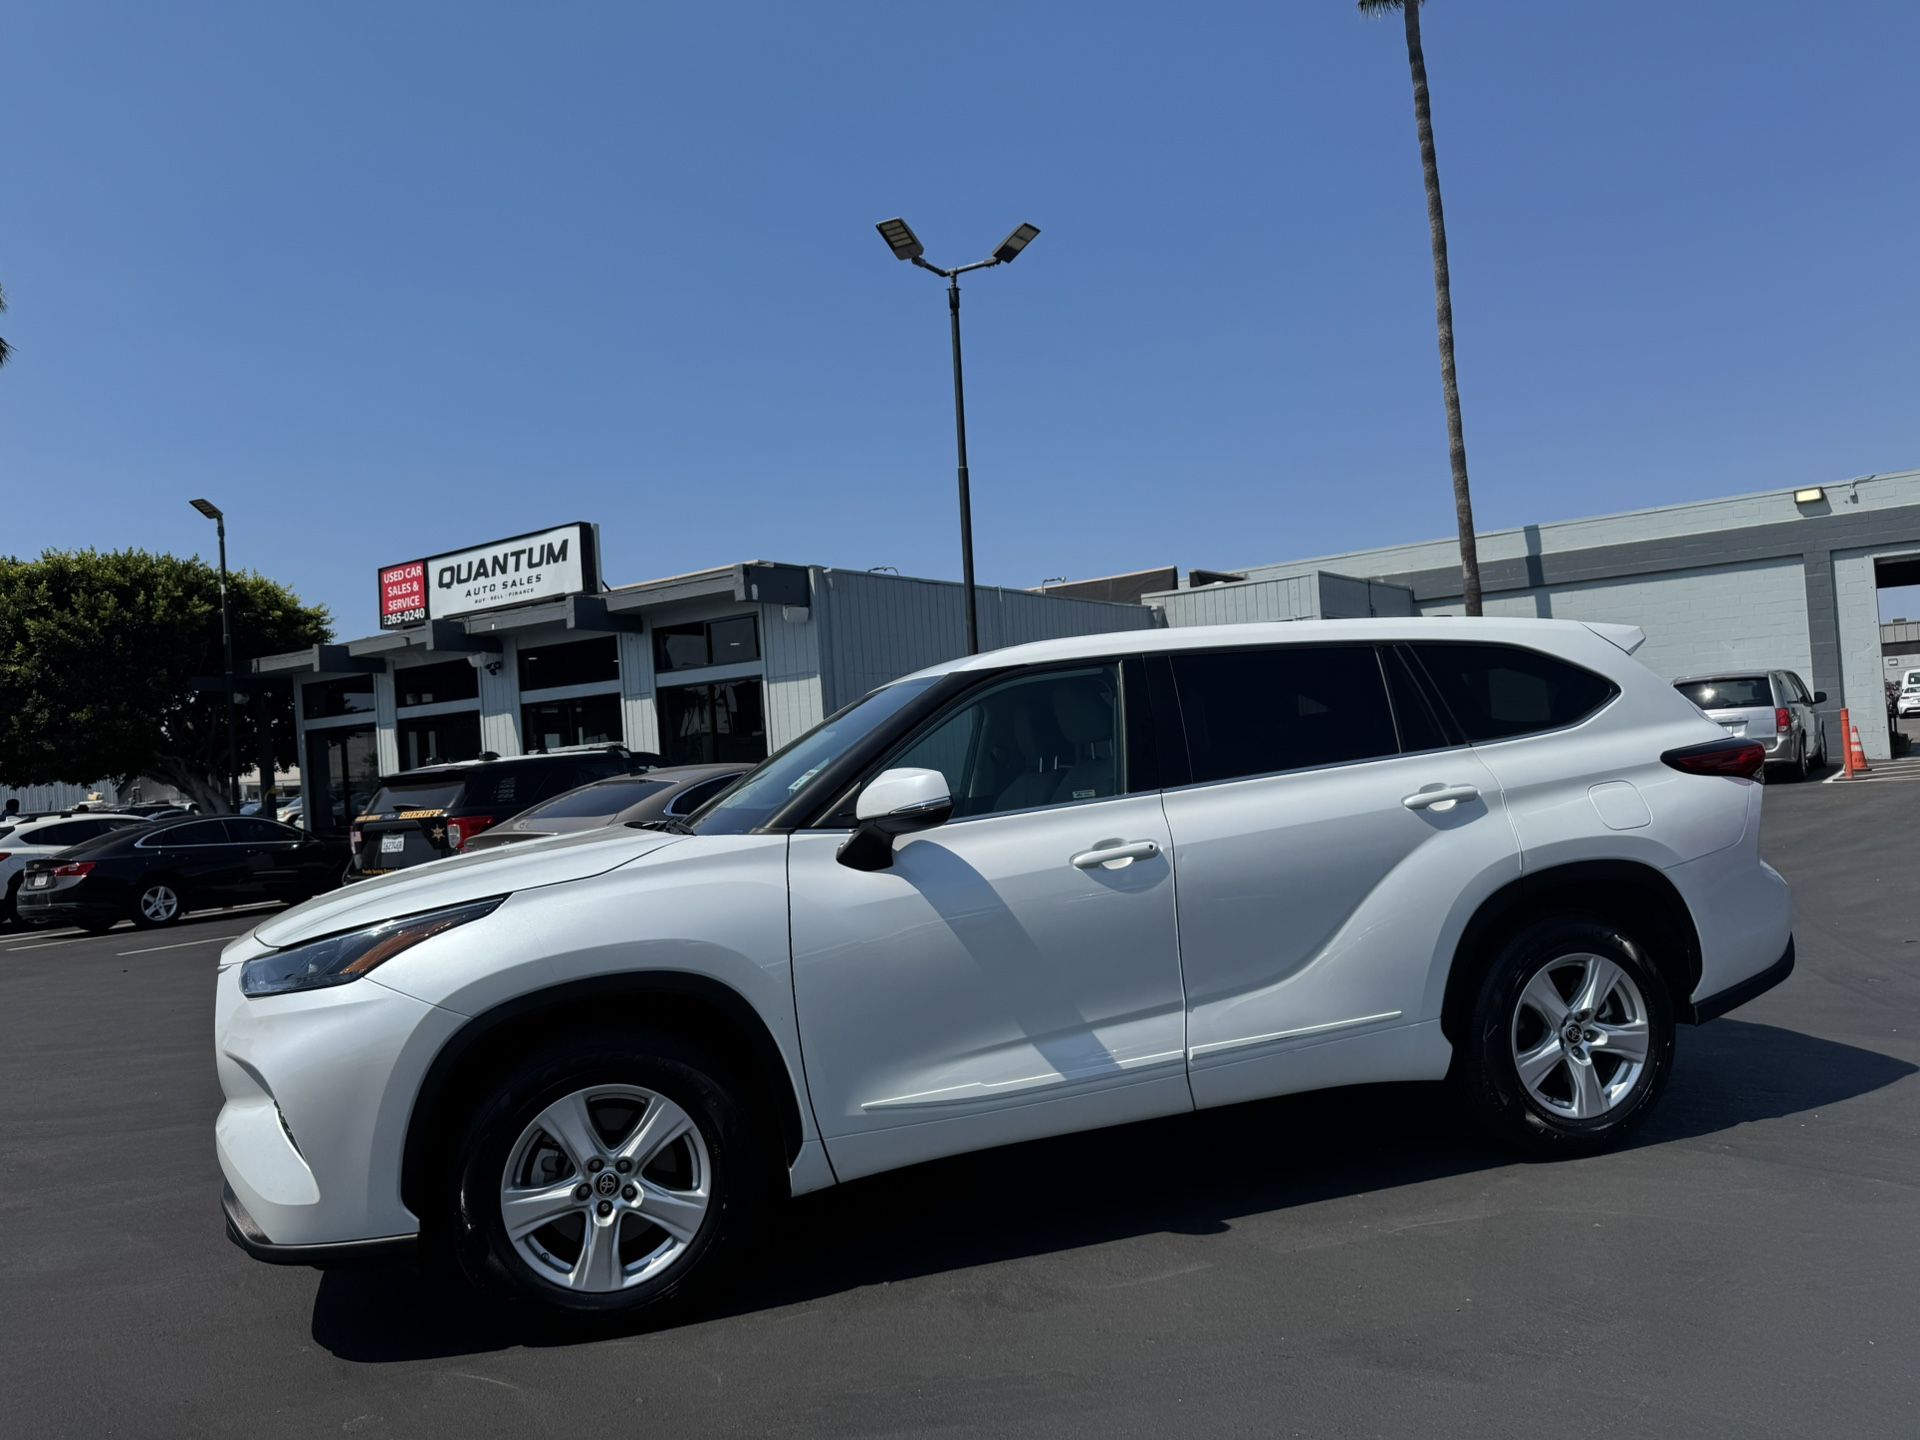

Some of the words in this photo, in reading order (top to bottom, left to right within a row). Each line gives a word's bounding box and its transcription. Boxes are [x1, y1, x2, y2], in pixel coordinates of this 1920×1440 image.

[438, 539, 568, 589] QUANTUM
[383, 570, 404, 584] USED
[405, 565, 422, 579] CAR
[387, 582, 411, 597] SALES
[412, 580, 420, 592] &
[465, 583, 496, 598] AUTO
[502, 573, 542, 589] SALES
[508, 588, 534, 597] FINANCE
[388, 595, 420, 611] SERVICE
[399, 809, 443, 819] SHERIFF
